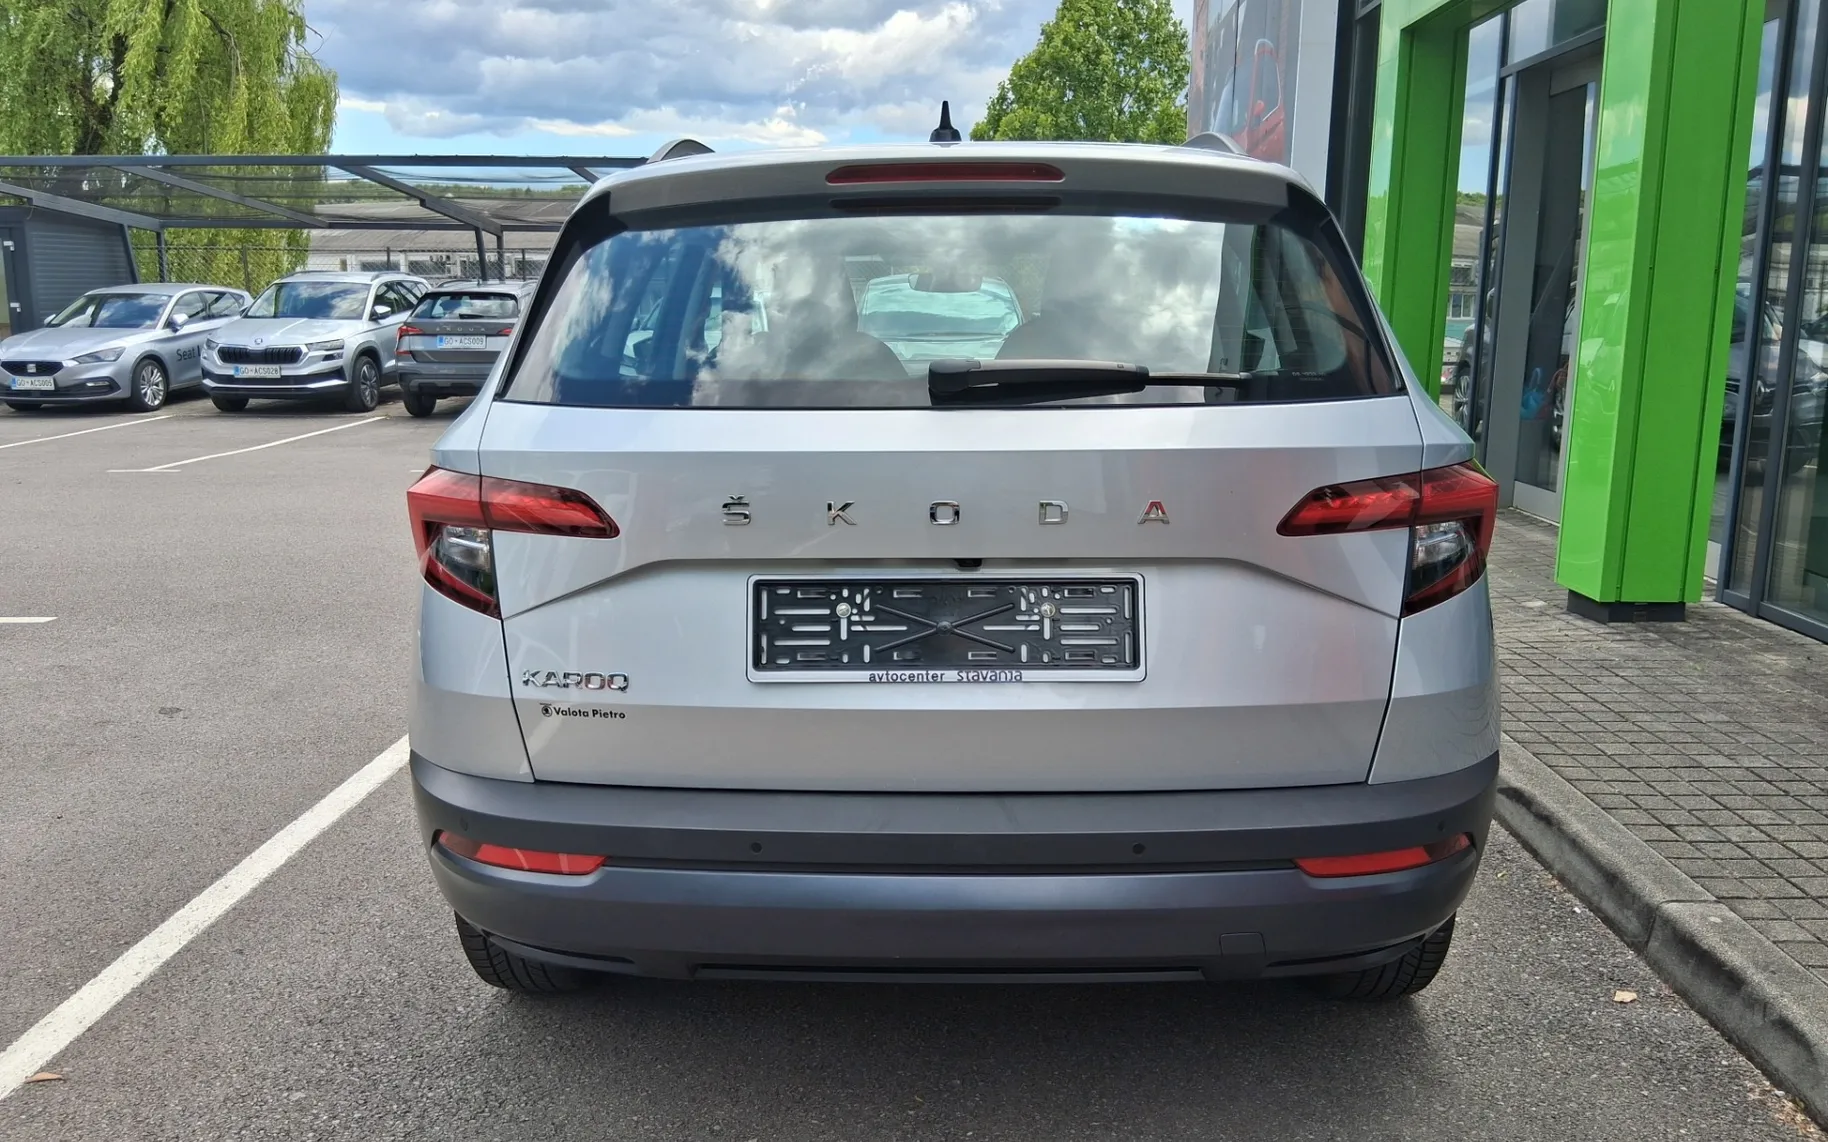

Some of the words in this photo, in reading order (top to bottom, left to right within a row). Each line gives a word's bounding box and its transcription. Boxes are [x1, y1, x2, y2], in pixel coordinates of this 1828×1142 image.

[176, 347, 196, 362] Seat
[722, 494, 1170, 526] ŠKODA
[522, 669, 629, 693] KAROQ
[868, 670, 945, 682] avtocenter
[553, 706, 589, 718] Valota
[592, 708, 626, 719] Pietro
